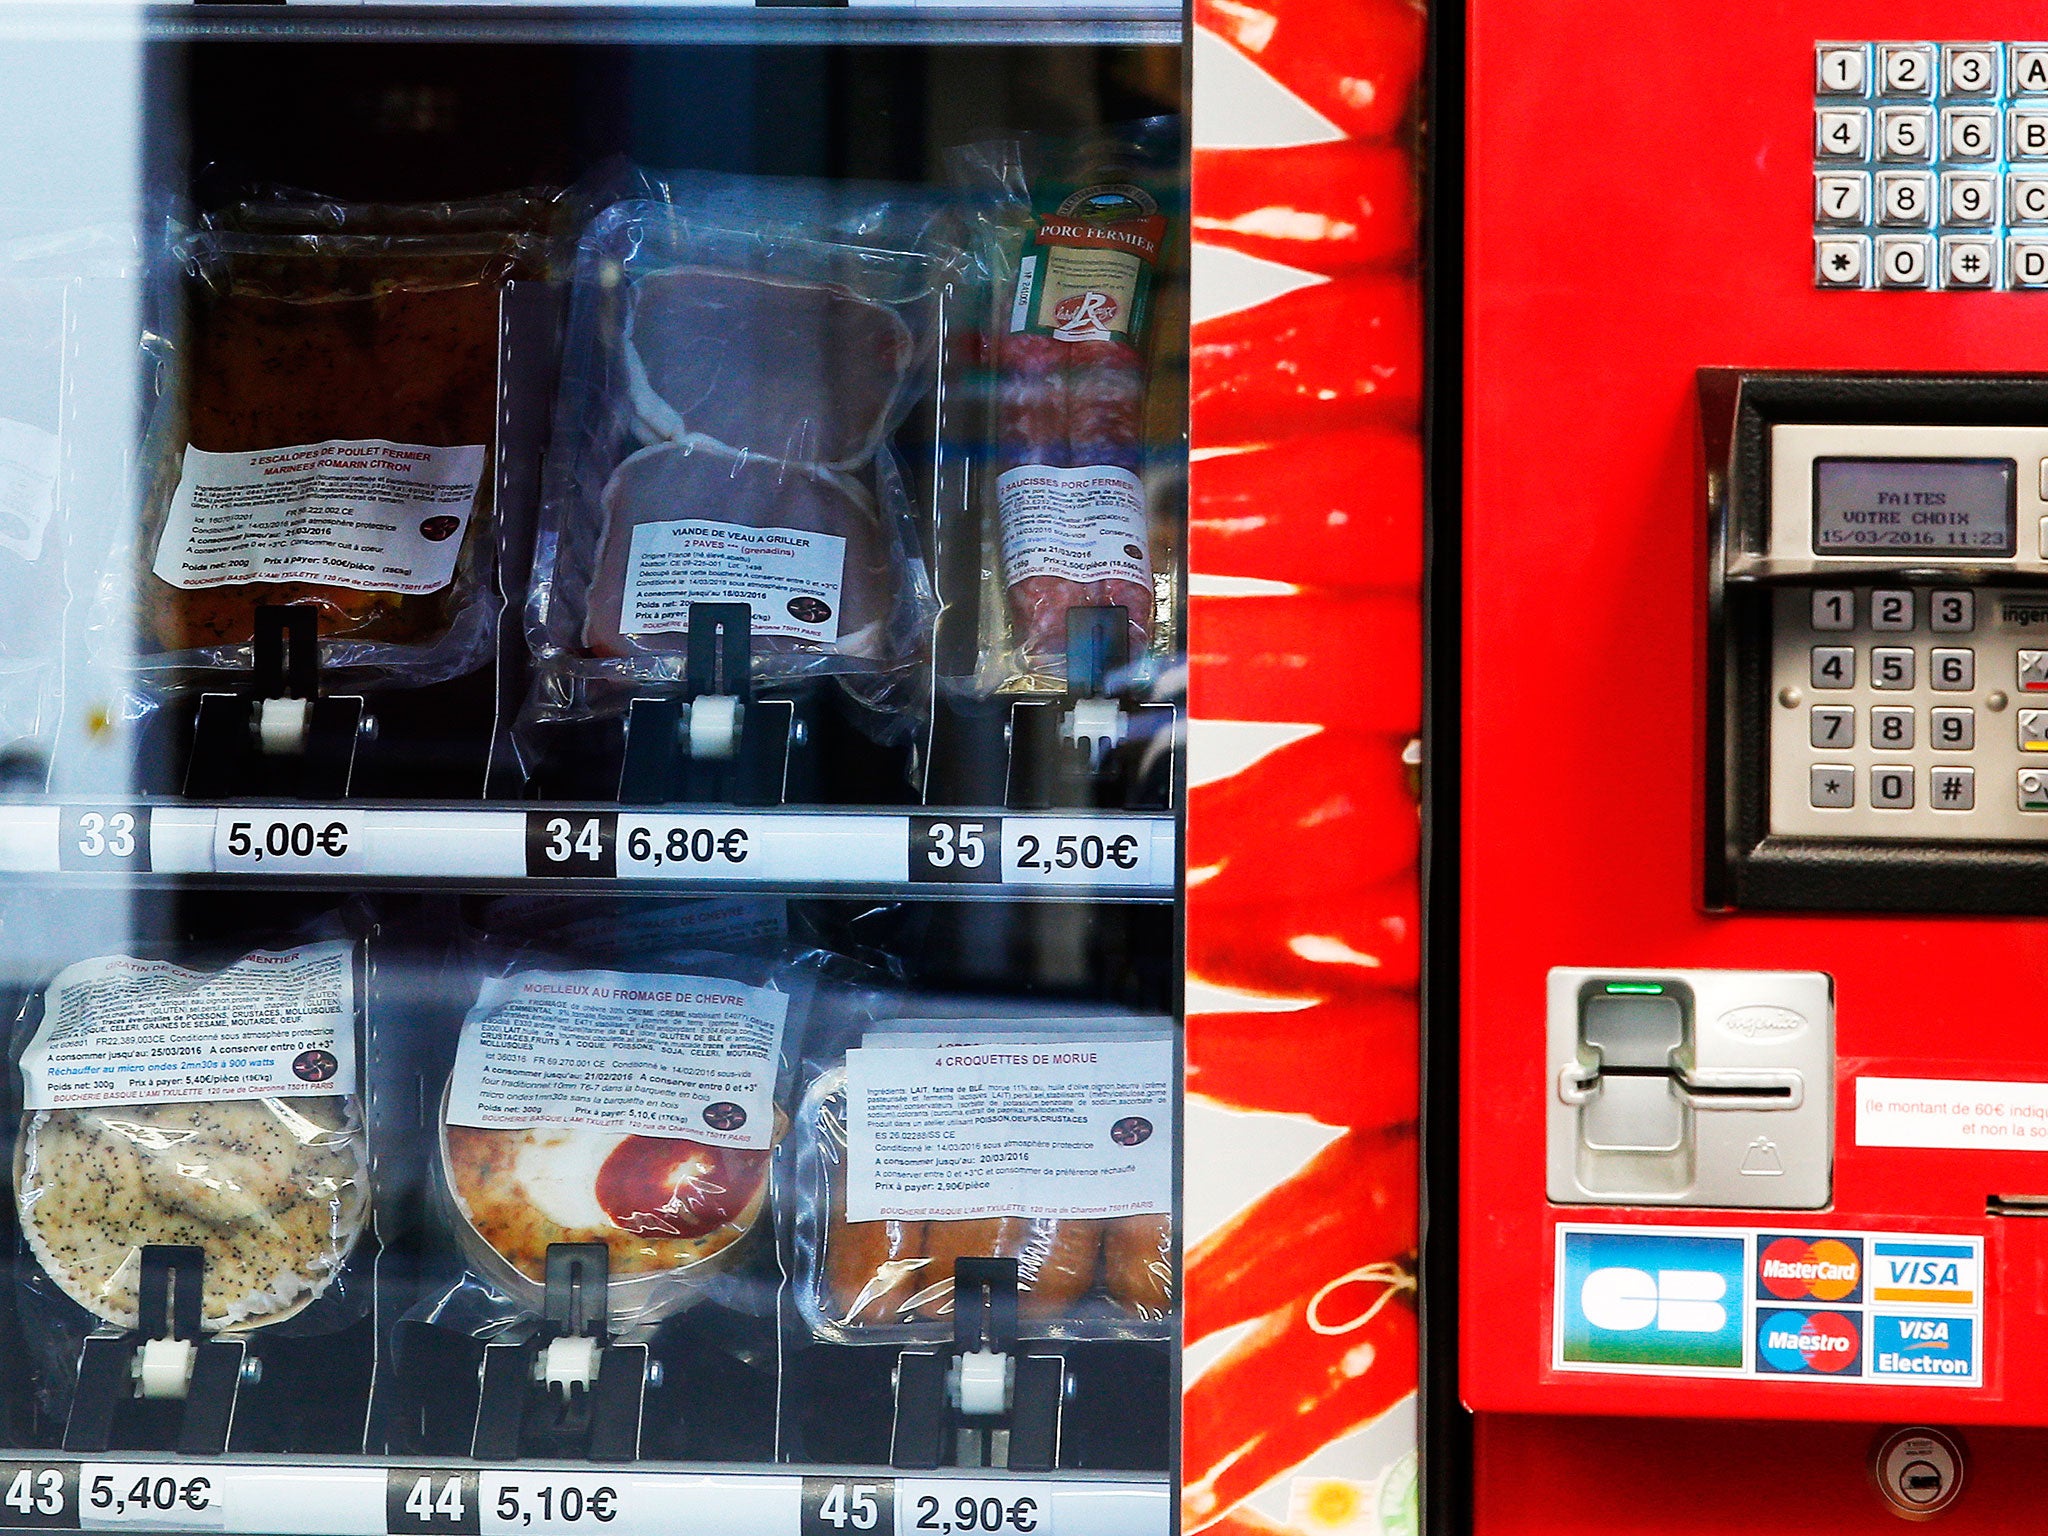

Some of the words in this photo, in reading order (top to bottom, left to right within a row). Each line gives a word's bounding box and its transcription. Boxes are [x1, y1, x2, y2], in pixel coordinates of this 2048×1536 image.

[1837, 59, 1846, 81] 1
[1898, 59, 1915, 82] 2
[1963, 59, 1979, 82] 3
[2028, 59, 2046, 82] A
[1833, 123, 1850, 144] 4
[1898, 123, 1915, 146] 5
[1964, 124, 1980, 146] 6
[2028, 125, 2045, 146] B
[1833, 187, 1849, 209] 7
[1898, 187, 1914, 210] 8
[1963, 188, 1979, 210] 9
[2026, 189, 2045, 211] C
[1040, 226, 1083, 237] PORC
[1087, 228, 1154, 253] FERMIER
[2026, 253, 2044, 275] D
[259, 451, 318, 465] ESCALOPES
[321, 448, 333, 456] DE
[338, 447, 380, 456] POULET
[383, 448, 430, 461] FERMIER
[265, 462, 315, 475] MARINEES
[318, 460, 367, 469] ROMARIN
[370, 460, 411, 471] CITRON
[1005, 479, 1058, 491] SAUCISSES
[1062, 480, 1089, 488] PORC
[1092, 479, 1134, 490] FERMIER
[1878, 492, 1946, 505] FAITES
[1843, 512, 1900, 524] VOTRE
[1912, 513, 1969, 525] CHOIX
[672, 528, 708, 536] VIANDE
[712, 529, 726, 537] DE
[729, 531, 755, 542] VEAU
[767, 536, 810, 547] GRILLER
[693, 540, 724, 549] PAVES
[741, 547, 795, 557] (grenadins)
[1823, 531, 1934, 544] 15/03/2016
[1949, 531, 2003, 544] 11:23
[1826, 596, 1841, 622] 1
[1883, 598, 1902, 622] 2
[1942, 598, 1962, 623] 3
[1822, 656, 1842, 680] 4
[1883, 656, 1902, 681] 5
[1942, 658, 1961, 682] 6
[1823, 716, 1842, 739] 7
[1883, 716, 1902, 740] 8
[1942, 717, 1962, 741] 9
[78, 812, 136, 857] 33
[228, 821, 350, 862] 5,00€
[545, 818, 602, 861] 34
[927, 823, 985, 868] 35
[628, 827, 749, 867] 6,80€
[1017, 835, 1138, 874] 2,50€
[523, 984, 589, 996] MOELLEUX
[592, 988, 609, 998] AU
[613, 990, 672, 1002] FROMAGE
[676, 993, 691, 1002] DE
[696, 994, 744, 1006] CHEVRE
[56, 1052, 106, 1061] consommer
[109, 1051, 148, 1060] jusqu'au:
[151, 1047, 202, 1056] 25/03/2016
[220, 1045, 267, 1053] conserver
[271, 1042, 296, 1051] entre
[936, 1058, 942, 1066] 4
[946, 1054, 1028, 1066] CROQUETTES
[1032, 1055, 1048, 1064] DE
[1053, 1053, 1097, 1064] MORUE
[118, 1064, 144, 1072] micro
[148, 1063, 177, 1071] ondes
[48, 1082, 71, 1091] Poids
[93, 1081, 114, 1089] 300g
[157, 1078, 183, 1087] payer:
[492, 1067, 542, 1078] consommer
[650, 1075, 699, 1088] conserver
[700, 1082, 723, 1091] entre
[478, 1103, 501, 1112] Poids
[575, 1106, 591, 1114] Prix
[1889, 1101, 1946, 1114] montant
[1952, 1103, 1969, 1115] de
[1975, 1103, 2005, 1117] 60€
[2010, 1105, 2048, 1119] indiq
[1963, 1123, 1975, 1134] et
[1981, 1125, 2007, 1135] non
[2012, 1124, 2024, 1137] la
[884, 1158, 933, 1166] consommer
[936, 1157, 975, 1166] jusqu'au:
[980, 1152, 1029, 1163] 20/03/2016
[875, 1182, 893, 1190] Prix
[896, 1182, 901, 1190] à
[904, 1182, 935, 1192] payer:
[937, 1181, 990, 1191] 2,90€/pièce
[1763, 1260, 1857, 1280] MasterCard
[1890, 1261, 1959, 1285] VISA
[1581, 1267, 1727, 1333] CB
[1899, 1320, 1948, 1340] VISA
[1768, 1331, 1849, 1352] Maestro
[1878, 1353, 1968, 1375] Electron
[5, 1469, 64, 1514] 43
[91, 1476, 210, 1514] 5,40€
[406, 1477, 464, 1521] 44
[497, 1487, 617, 1526] 5,10€
[820, 1484, 878, 1529] 45
[916, 1496, 1037, 1535] 2,90€
